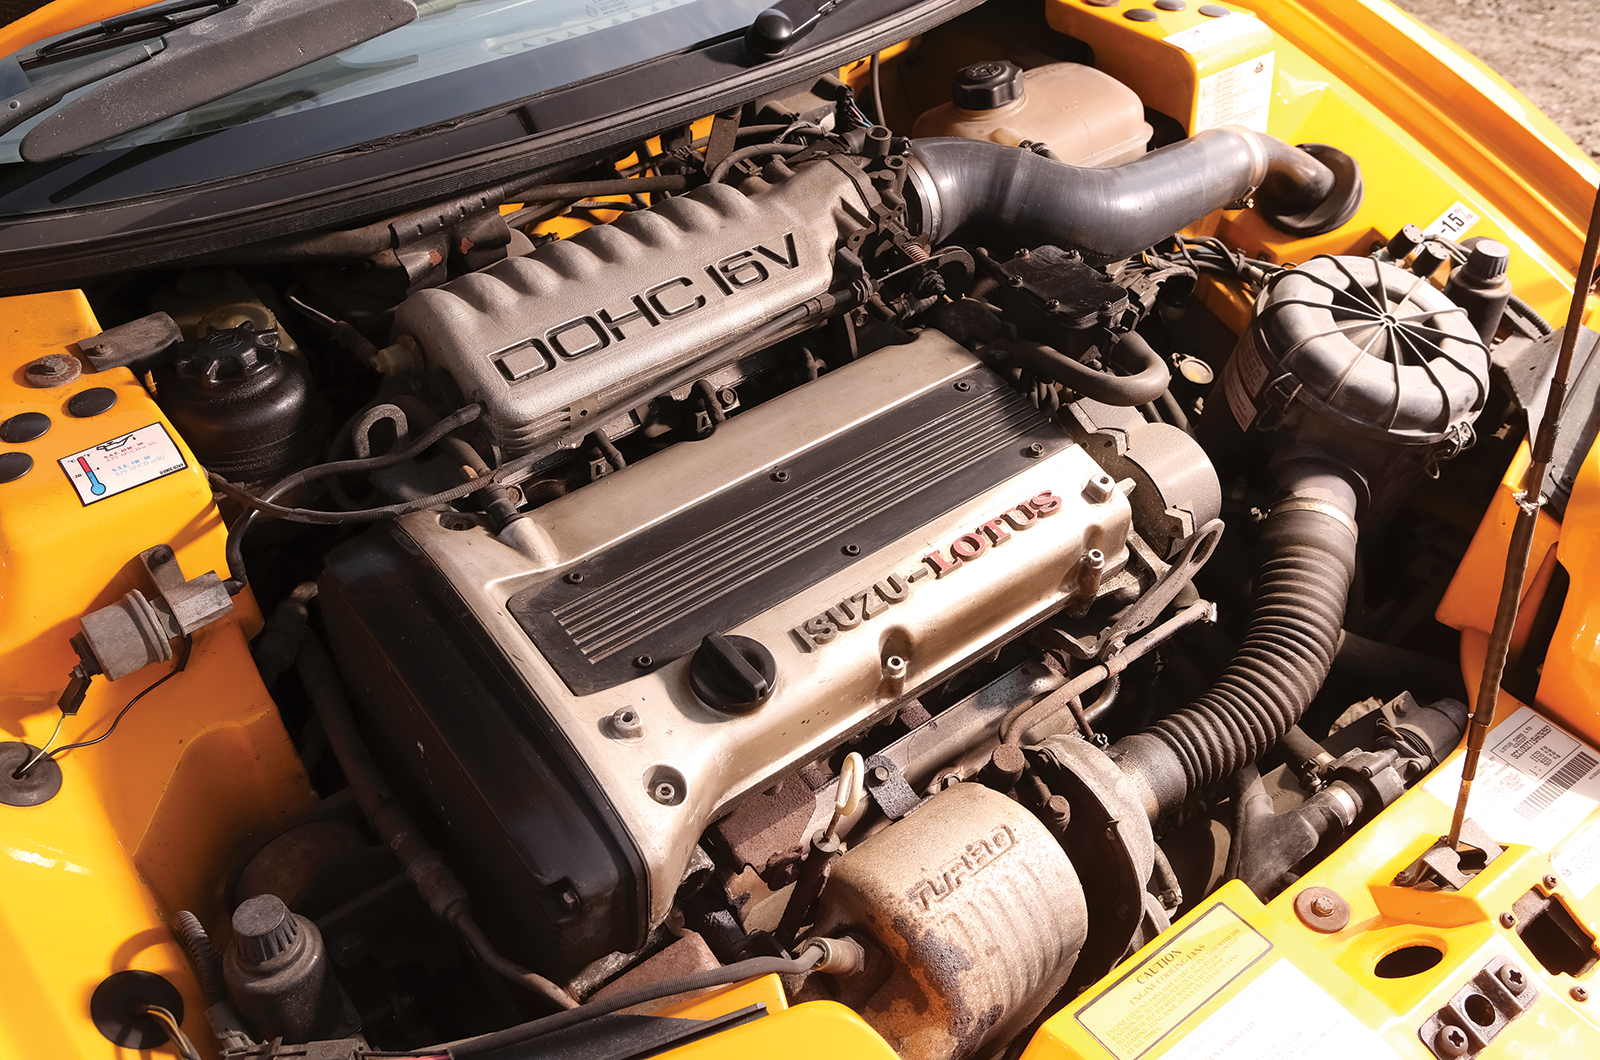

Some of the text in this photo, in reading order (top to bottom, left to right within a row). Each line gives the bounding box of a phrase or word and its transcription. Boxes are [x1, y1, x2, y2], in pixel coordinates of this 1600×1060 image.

[487, 231, 800, 387] DOHC 16V
[787, 489, 1062, 654] ISUZU-LOTUS
[1498, 741, 1513, 753] LOTUS
[1129, 943, 1205, 1005] ENGINE COOLING FANS
[1135, 947, 1181, 985] CAUTION
[1106, 1020, 1125, 1036] ENGINE
[1125, 1001, 1149, 1021] COOLING
